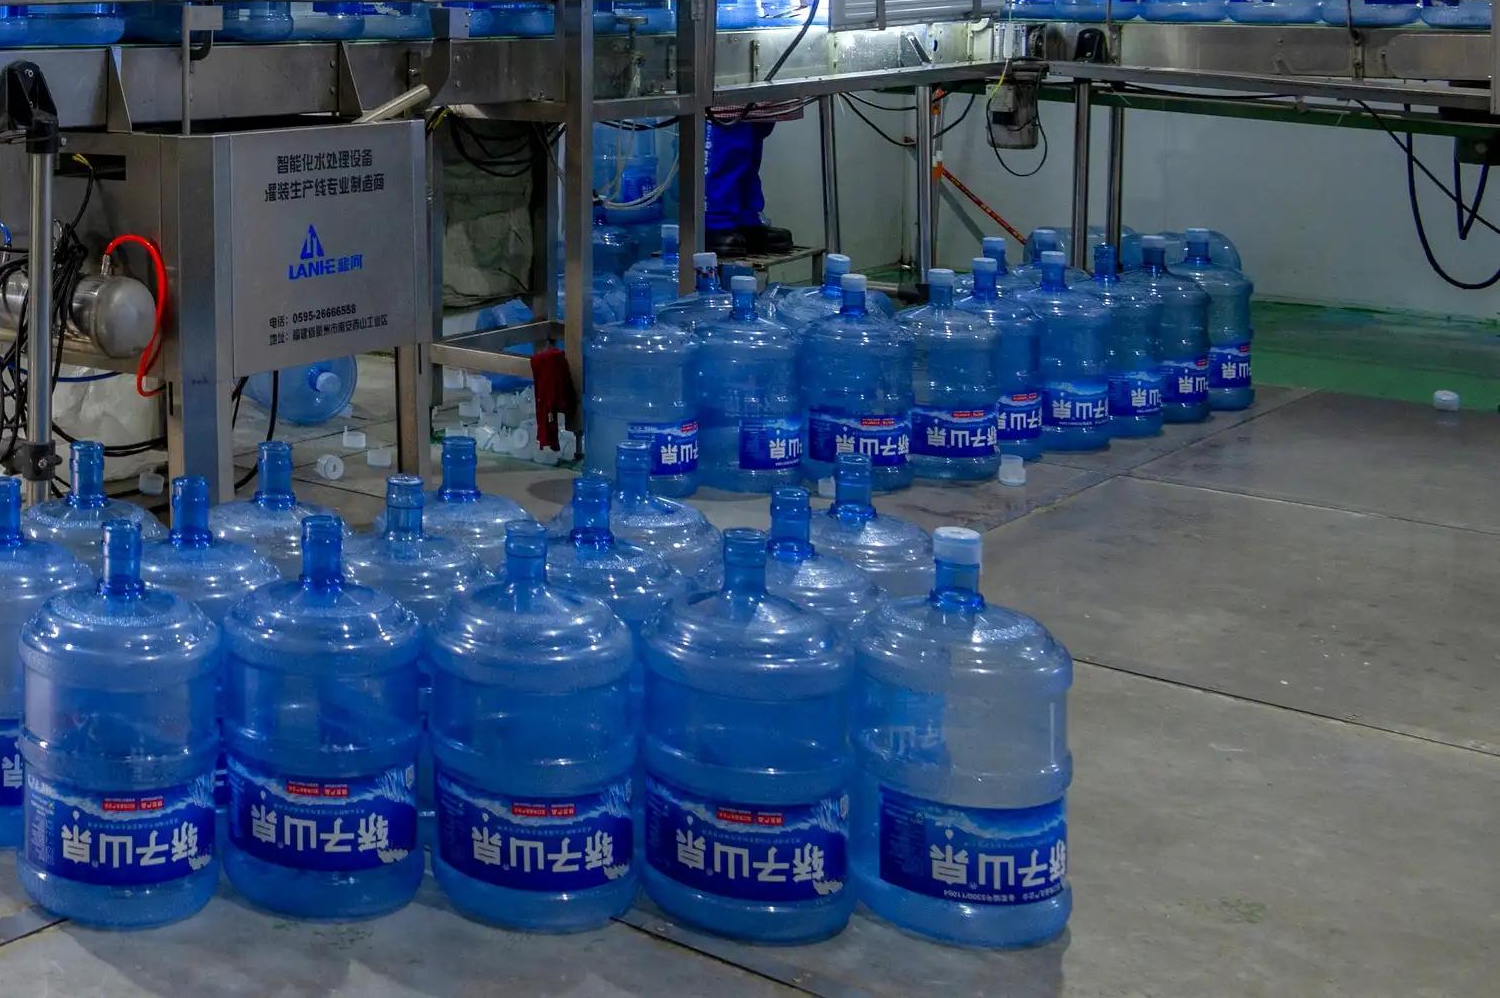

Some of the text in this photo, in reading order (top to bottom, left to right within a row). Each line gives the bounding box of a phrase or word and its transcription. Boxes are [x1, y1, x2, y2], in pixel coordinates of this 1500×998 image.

[276, 149, 373, 175] 智能化水处理设备
[264, 172, 385, 203] 灌装生产线专业制造商
[1179, 375, 1208, 394] 山泉
[1222, 362, 1252, 379] 山泉
[1131, 388, 1161, 407] 山泉
[769, 437, 802, 460] 山泉
[251, 804, 389, 853] 轿子山泉
[61, 820, 199, 869] 轿子山泉
[472, 827, 614, 873] 轿子山泉
[676, 828, 825, 883] 轿子山泉
[930, 839, 1067, 890] 轿子山泉
